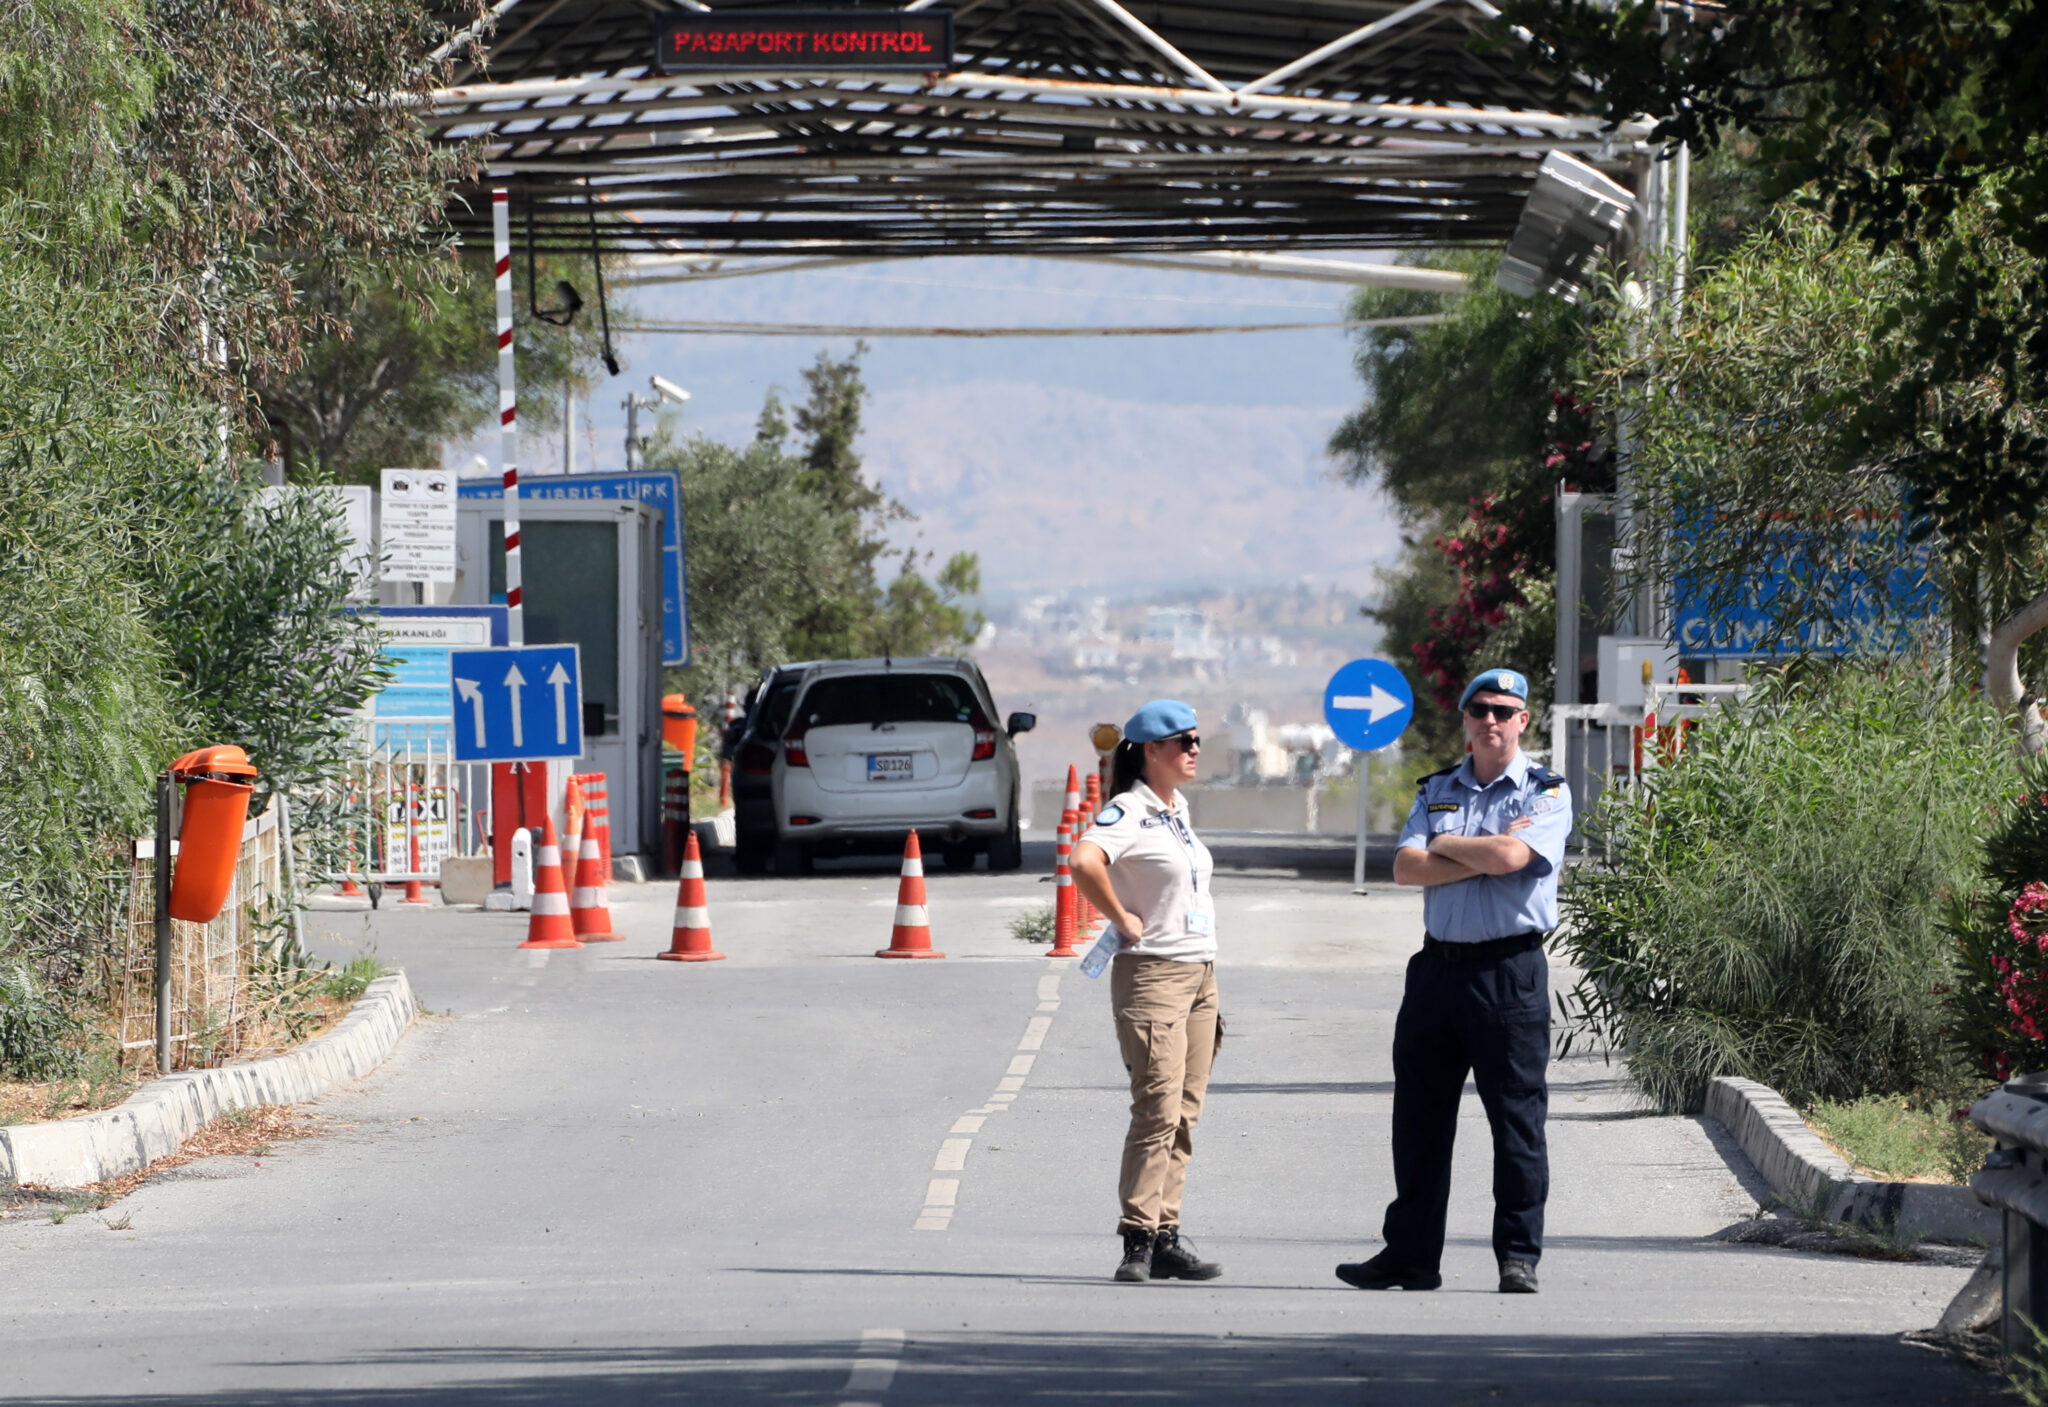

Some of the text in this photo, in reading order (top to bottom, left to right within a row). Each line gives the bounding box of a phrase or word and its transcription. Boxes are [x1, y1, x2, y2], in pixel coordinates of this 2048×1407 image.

[673, 31, 932, 53] PASAPORT KONTROL
[614, 481, 668, 499] TÜRK
